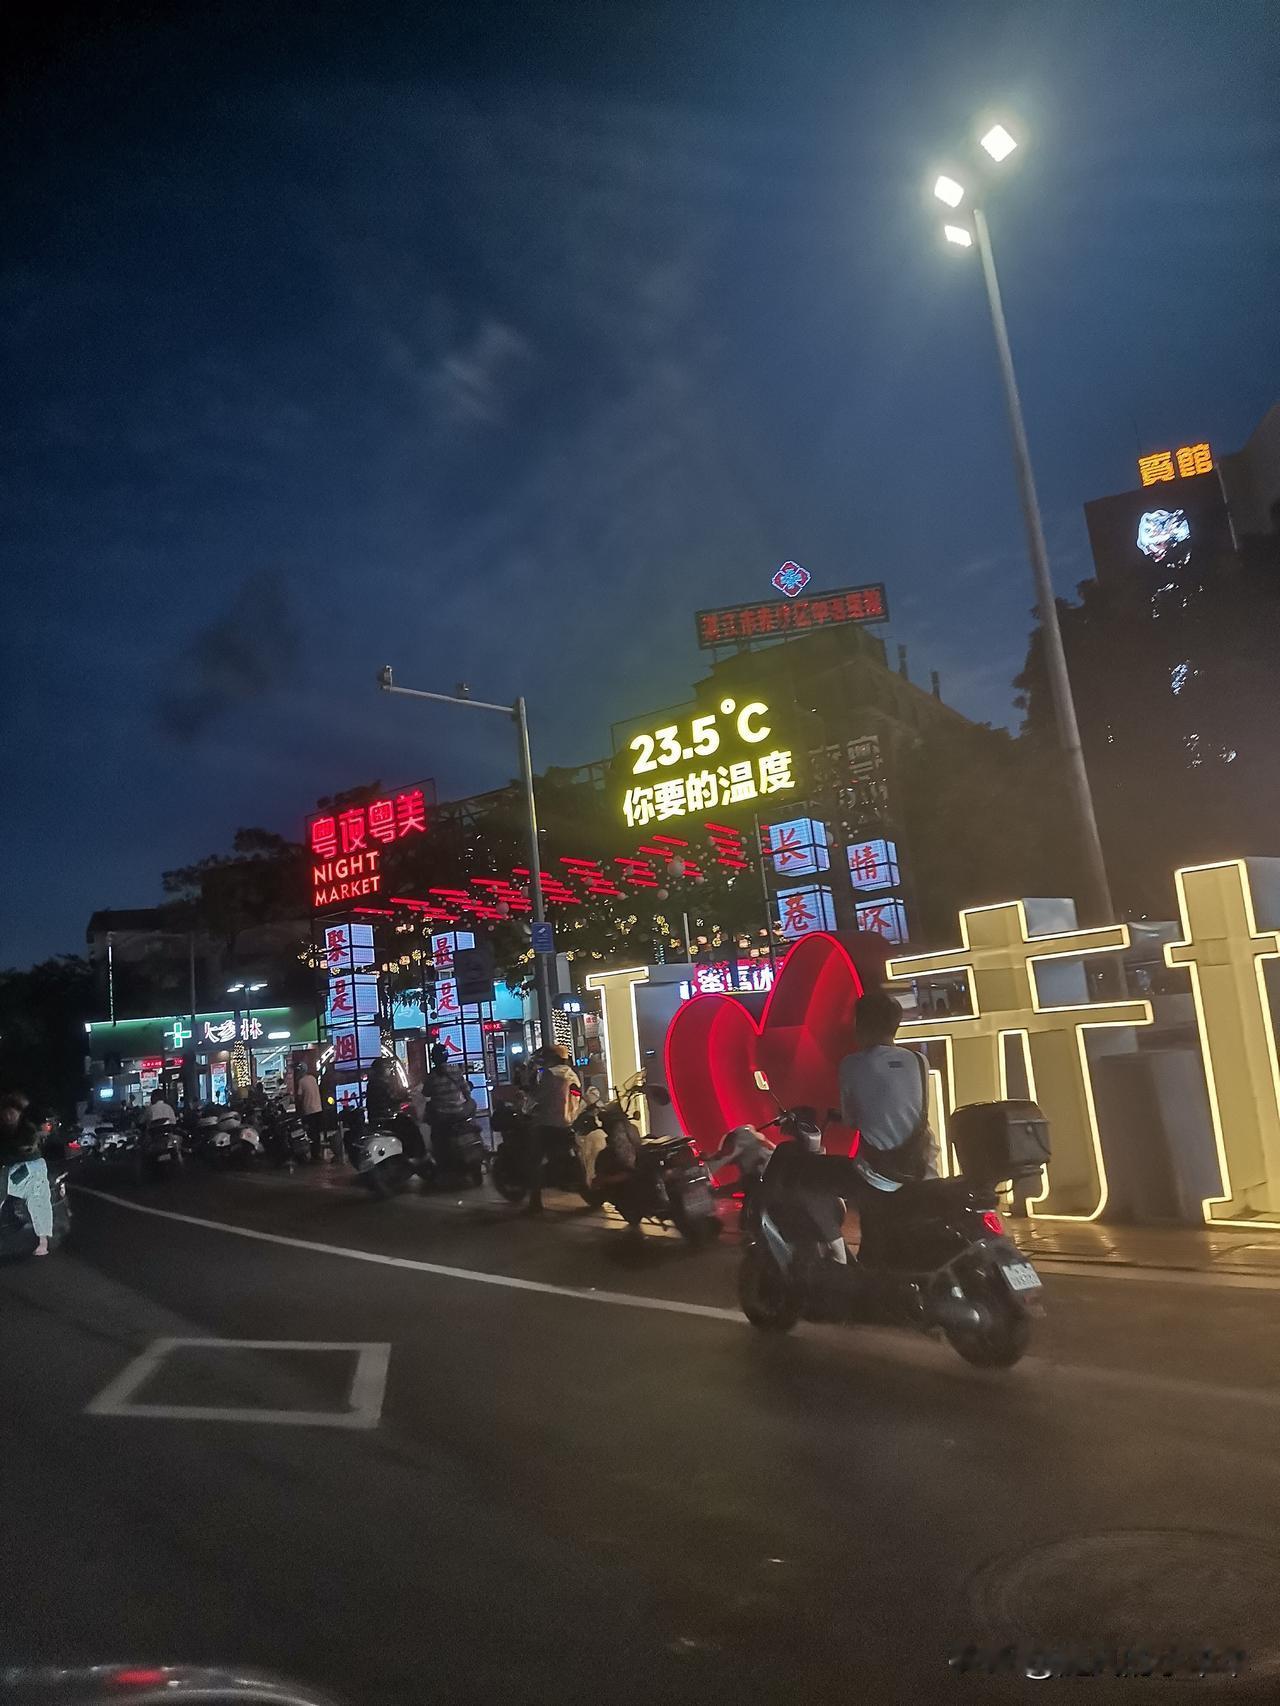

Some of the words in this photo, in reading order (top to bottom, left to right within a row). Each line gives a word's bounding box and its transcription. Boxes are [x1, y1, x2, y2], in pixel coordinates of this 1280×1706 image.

[622, 750, 796, 828] 你要的温度
[311, 789, 427, 859] 粤夜粤美
[313, 850, 380, 886] NIGHT
[314, 875, 381, 907] MARKET
